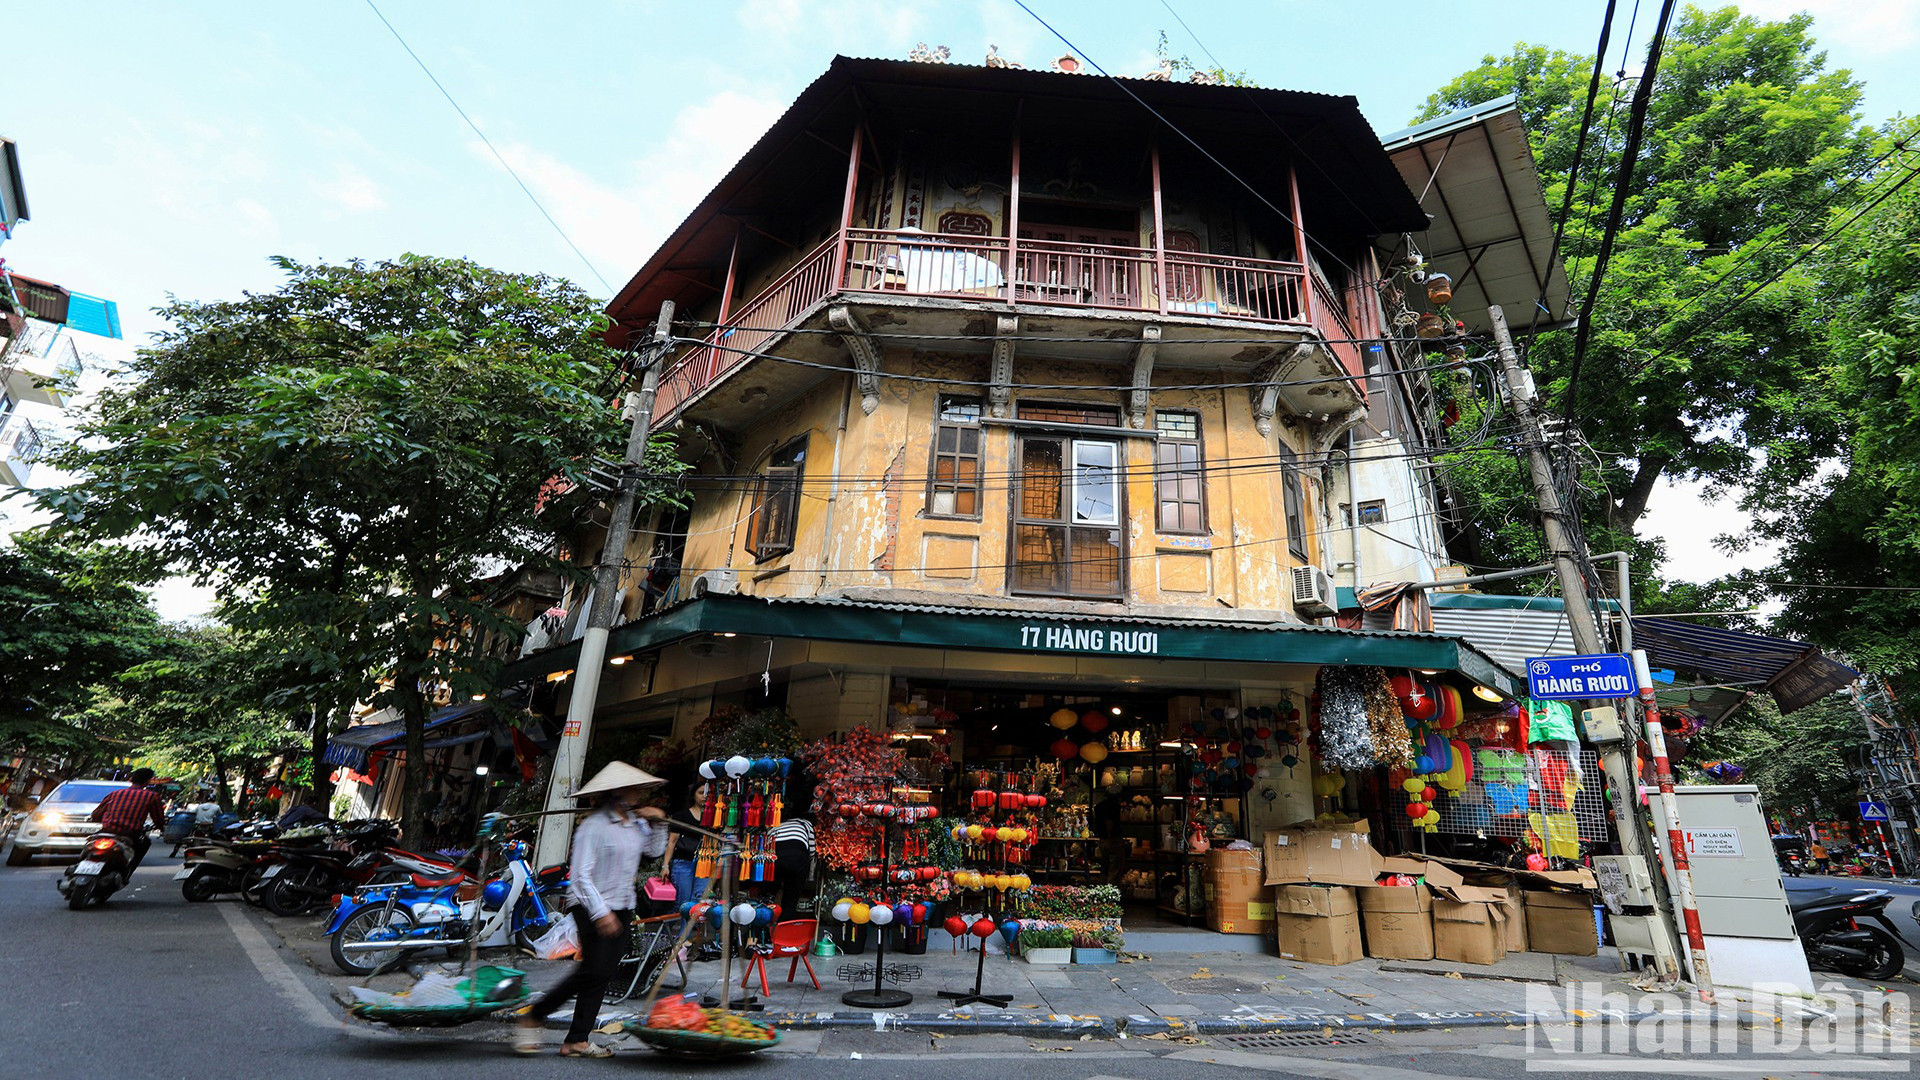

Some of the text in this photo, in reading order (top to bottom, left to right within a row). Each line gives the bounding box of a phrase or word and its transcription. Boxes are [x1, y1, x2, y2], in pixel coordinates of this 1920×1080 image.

[1021, 624, 1158, 654] 17 HÀNG RƯƠI
[1571, 661, 1601, 673] PHỐ
[1537, 674, 1629, 694] HÀNG RƯƠI
